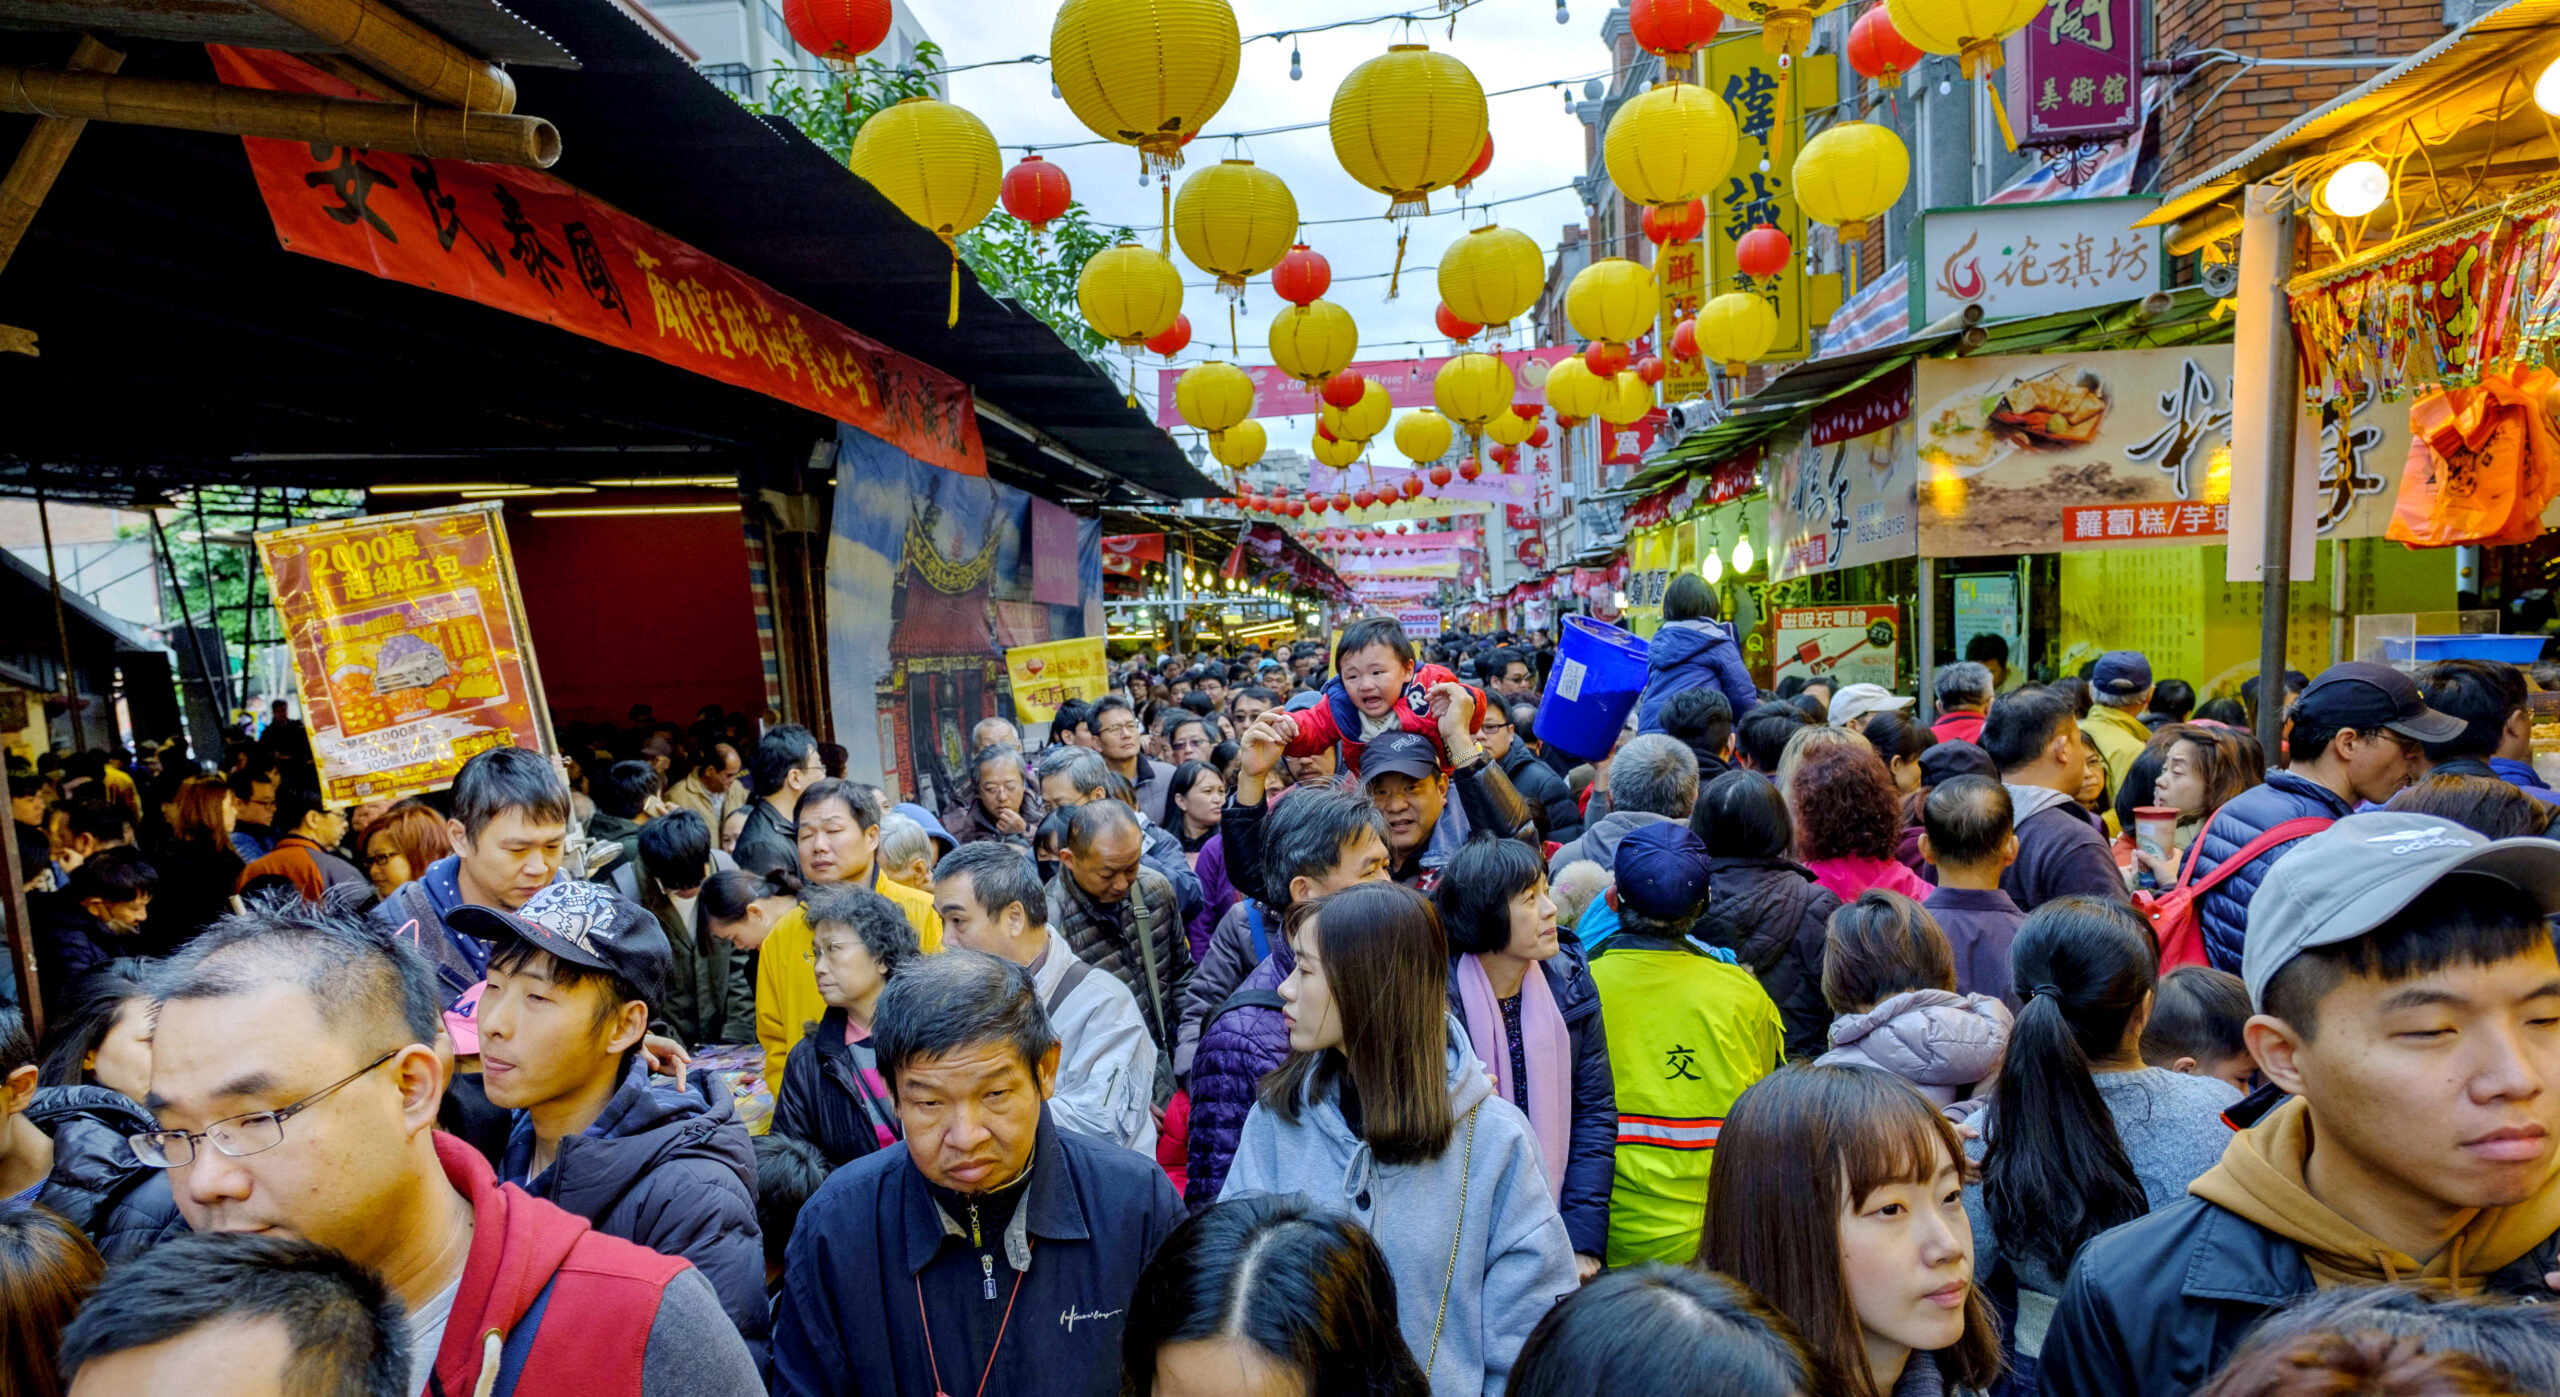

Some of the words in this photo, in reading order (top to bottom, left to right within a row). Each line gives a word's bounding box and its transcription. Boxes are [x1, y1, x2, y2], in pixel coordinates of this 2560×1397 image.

[2037, 73, 2128, 111] 美術館
[1723, 67, 1792, 245] 偉誠
[1994, 233, 2149, 288] 花旗坊
[342, 553, 463, 602] 超級紅包
[1781, 610, 1867, 629] 磁吸充電線
[1407, 690, 1429, 711] R
[1390, 735, 1422, 752] FILA
[2391, 836, 2473, 855] adidas
[1665, 1044, 1702, 1080] 交
